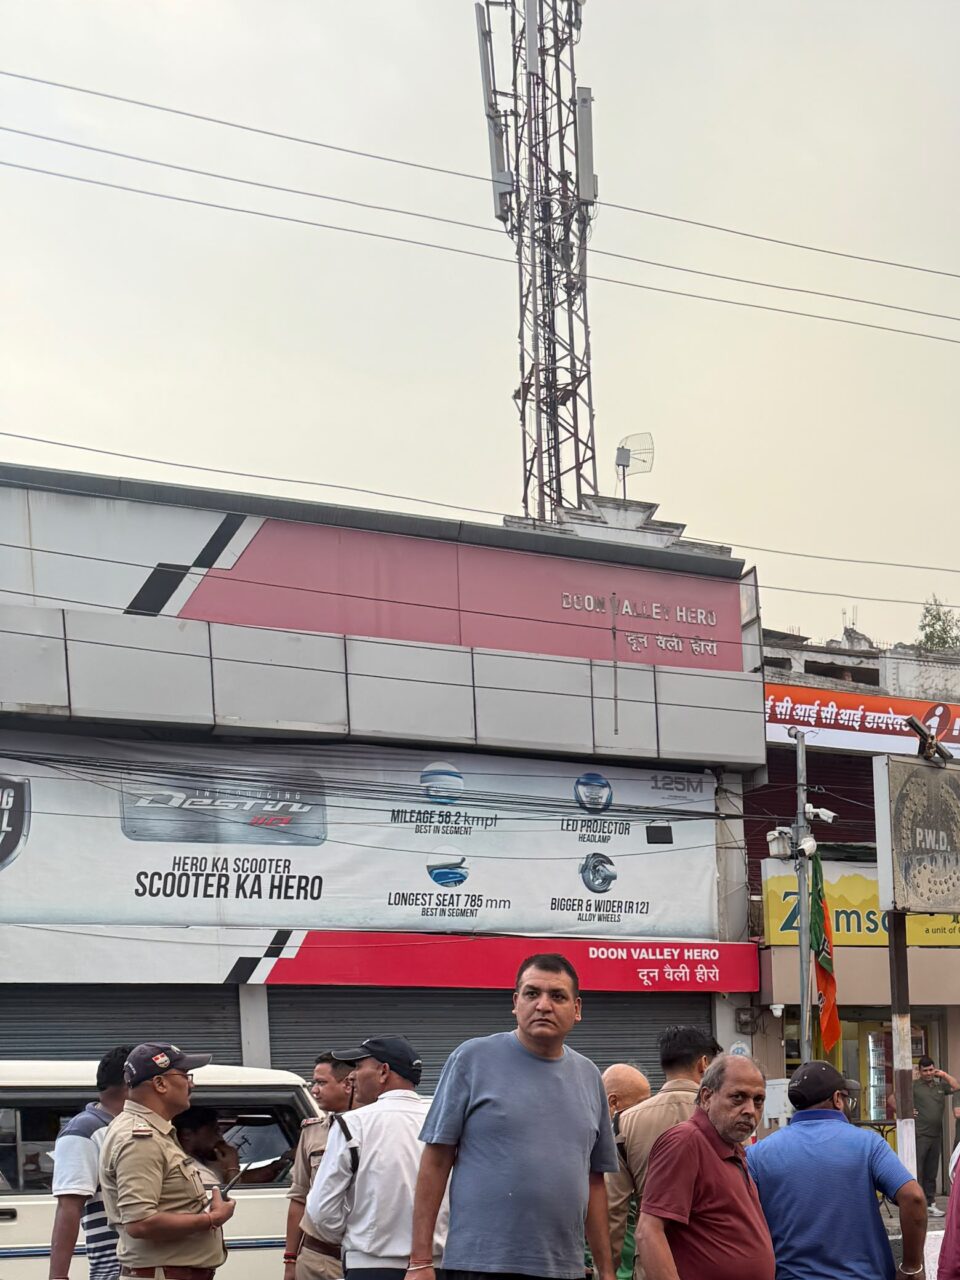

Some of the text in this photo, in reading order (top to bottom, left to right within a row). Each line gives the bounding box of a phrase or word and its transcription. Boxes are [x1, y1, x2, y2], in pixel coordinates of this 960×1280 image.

[676, 606, 717, 626] HERO
[775, 696, 793, 720] सी
[793, 700, 820, 726] आई
[821, 701, 838, 725] सी
[838, 704, 864, 731] आई
[390, 808, 436, 824] MILEAGE
[463, 812, 498, 830] kmpl
[560, 818, 630, 836] LED PROJECTOR
[414, 824, 472, 836] BEST IN SEGMENT
[578, 834, 611, 844] HEADLAMP
[916, 828, 950, 851] P.W.D.
[172, 856, 291, 874] HERO KA SCOOTER
[134, 871, 323, 900] SCOOTER KA HERO
[388, 892, 511, 909] LONGEST SEAT 785 mm
[550, 898, 584, 912] BIGGER
[586, 899, 592, 912] &
[594, 900, 624, 914] WIDER
[421, 907, 478, 918] BEST IN SEGMENT
[578, 913, 621, 922] ALLOY WHEELS
[932, 926, 947, 934] unit
[948, 926, 957, 934] of
[588, 947, 720, 960] DOON VALLEY HERO
[636, 964, 720, 986] दून वैली हीरो
